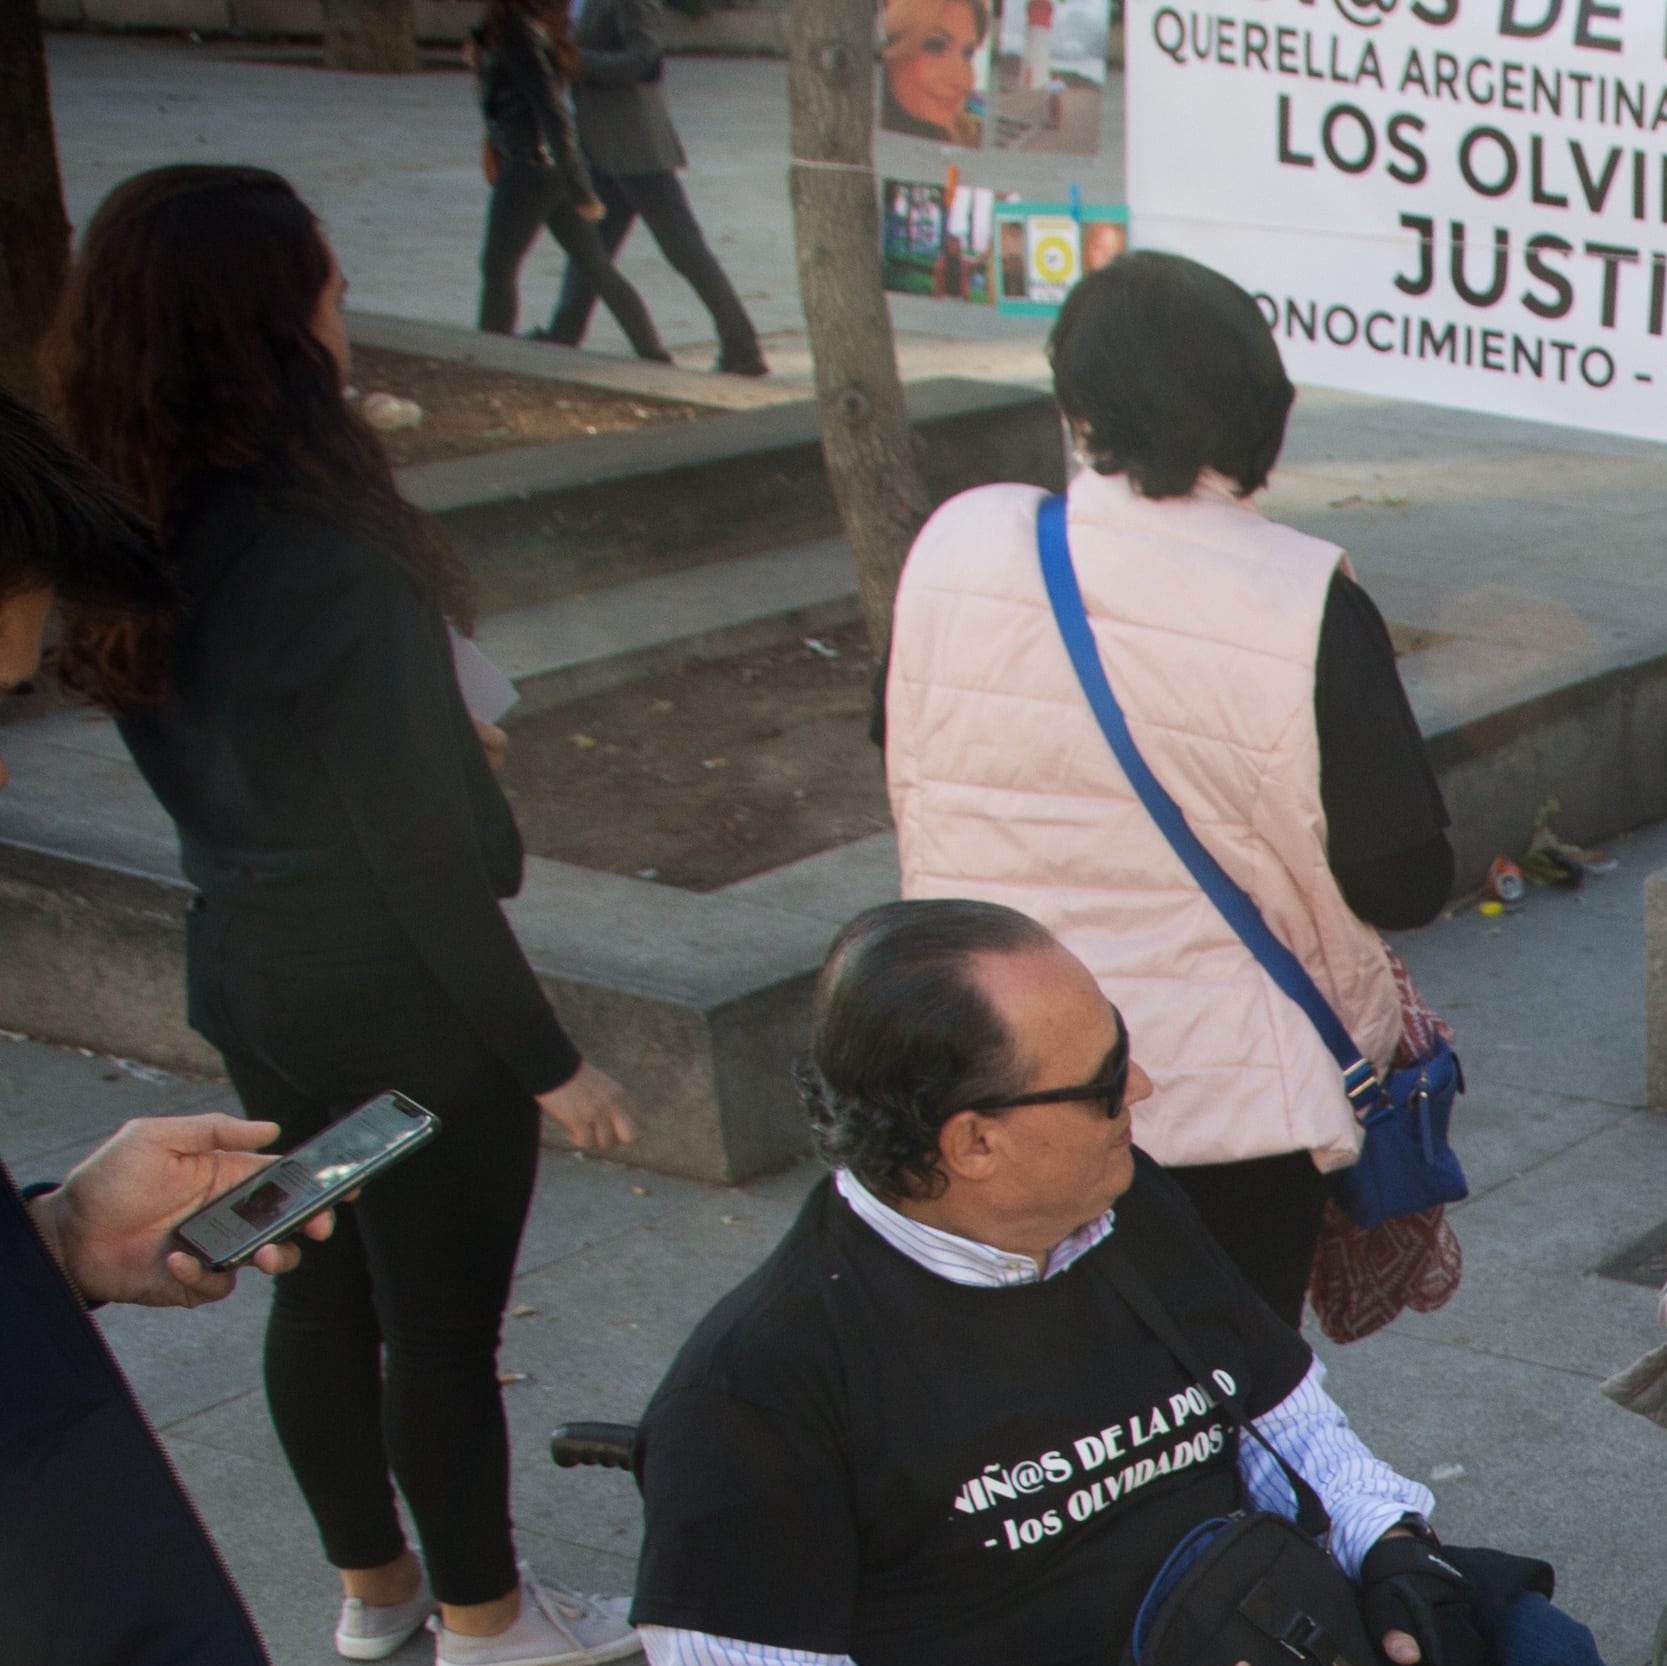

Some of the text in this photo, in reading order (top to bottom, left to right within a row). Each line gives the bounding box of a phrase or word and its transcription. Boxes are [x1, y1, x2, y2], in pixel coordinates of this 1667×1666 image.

[1152, 8, 1383, 90] QUERELLA
[1276, 94, 1428, 185] LOS
[1073, 1423, 1126, 1472] DE
[1129, 1405, 1170, 1447] LA
[1168, 1368, 1237, 1427] POLO
[1067, 1422, 1223, 1522] OLVIDADOS
